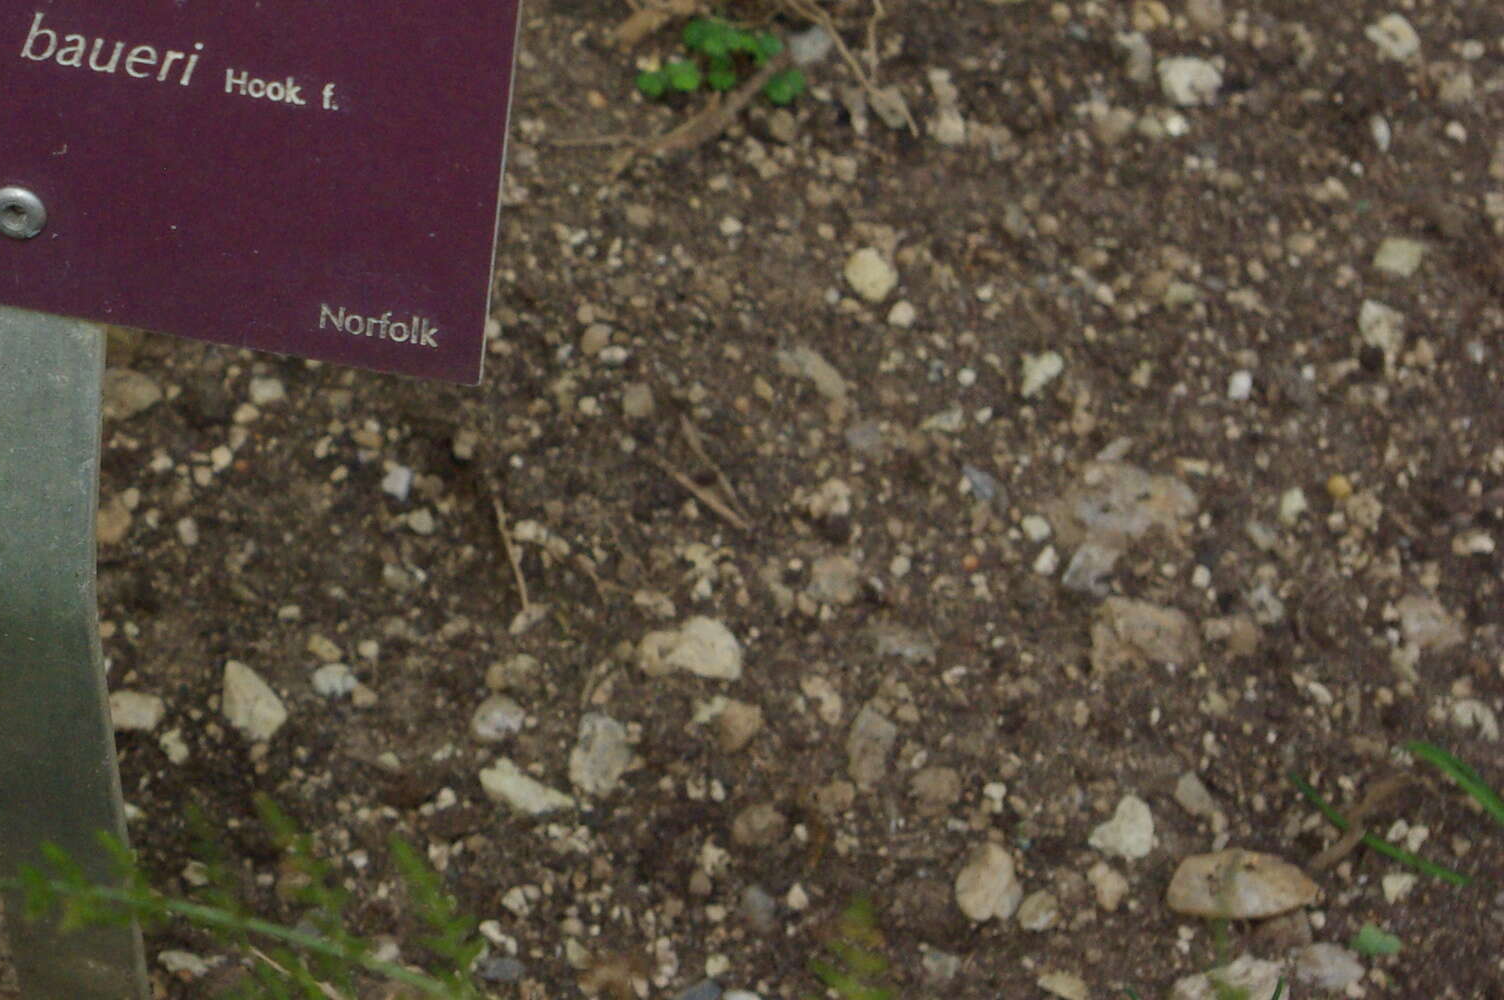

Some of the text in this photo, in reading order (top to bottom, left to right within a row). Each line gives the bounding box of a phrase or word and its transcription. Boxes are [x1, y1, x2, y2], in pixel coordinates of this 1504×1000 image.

[20, 12, 205, 87] baueri
[322, 83, 340, 111] f.
[318, 305, 439, 349] Norfolk
